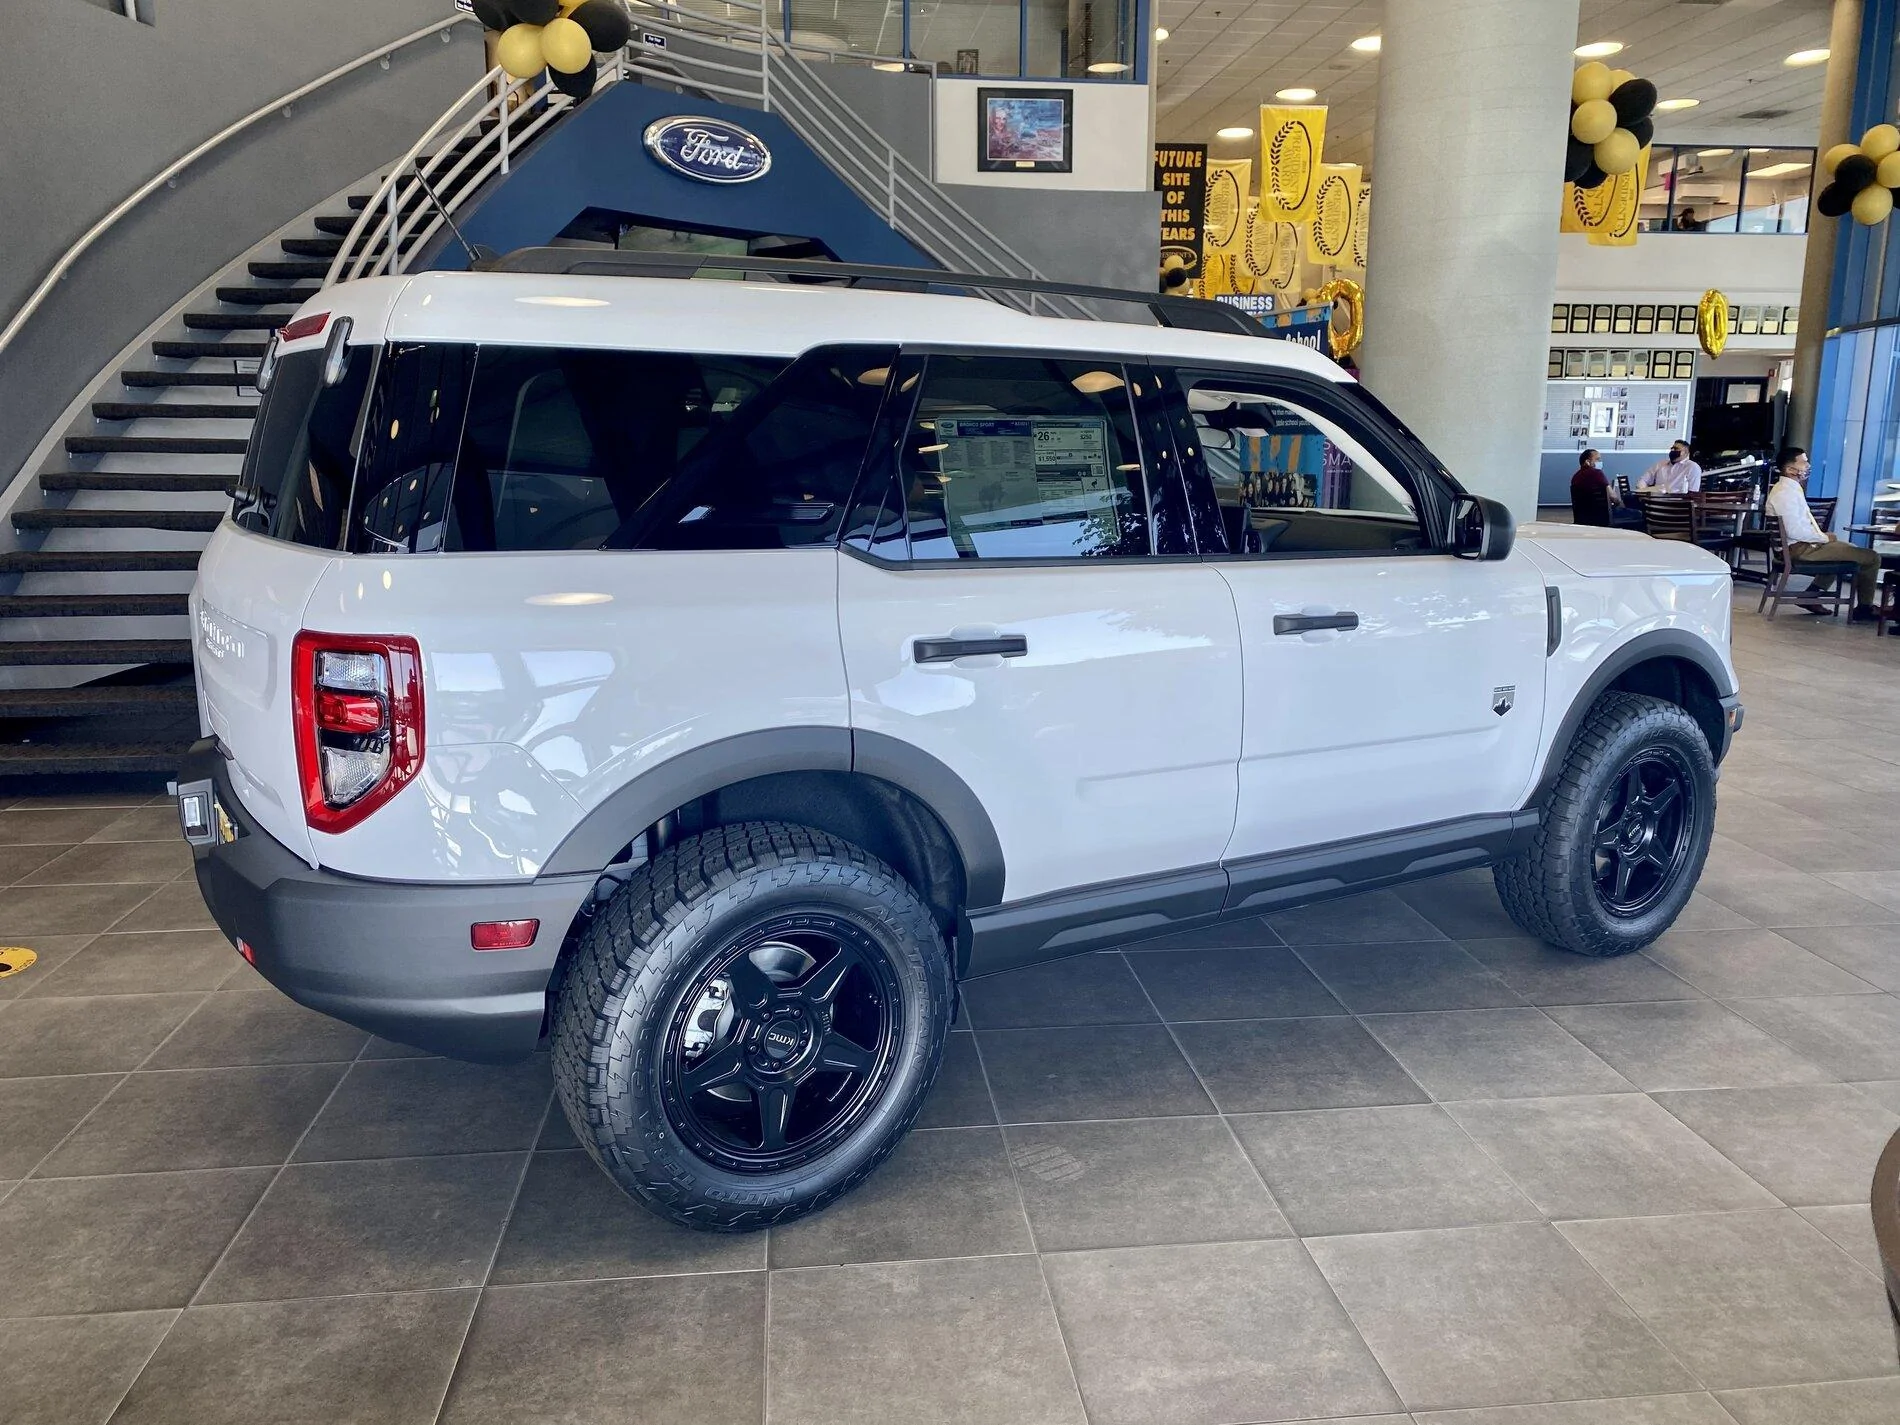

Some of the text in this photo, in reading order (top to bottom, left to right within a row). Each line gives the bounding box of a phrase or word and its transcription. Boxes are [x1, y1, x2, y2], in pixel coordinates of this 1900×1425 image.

[680, 128, 743, 170] Ford
[1154, 150, 1203, 168] FUTURE
[1281, 146, 1293, 187] AWARD
[1162, 172, 1191, 186] SITE
[1166, 190, 1185, 204] OF
[1616, 170, 1631, 231] ESIDENT'S
[1161, 208, 1190, 222] THIS
[1037, 431, 1050, 441] 26
[768, 1032, 795, 1046] KMC
[703, 1186, 796, 1208] NITTO
